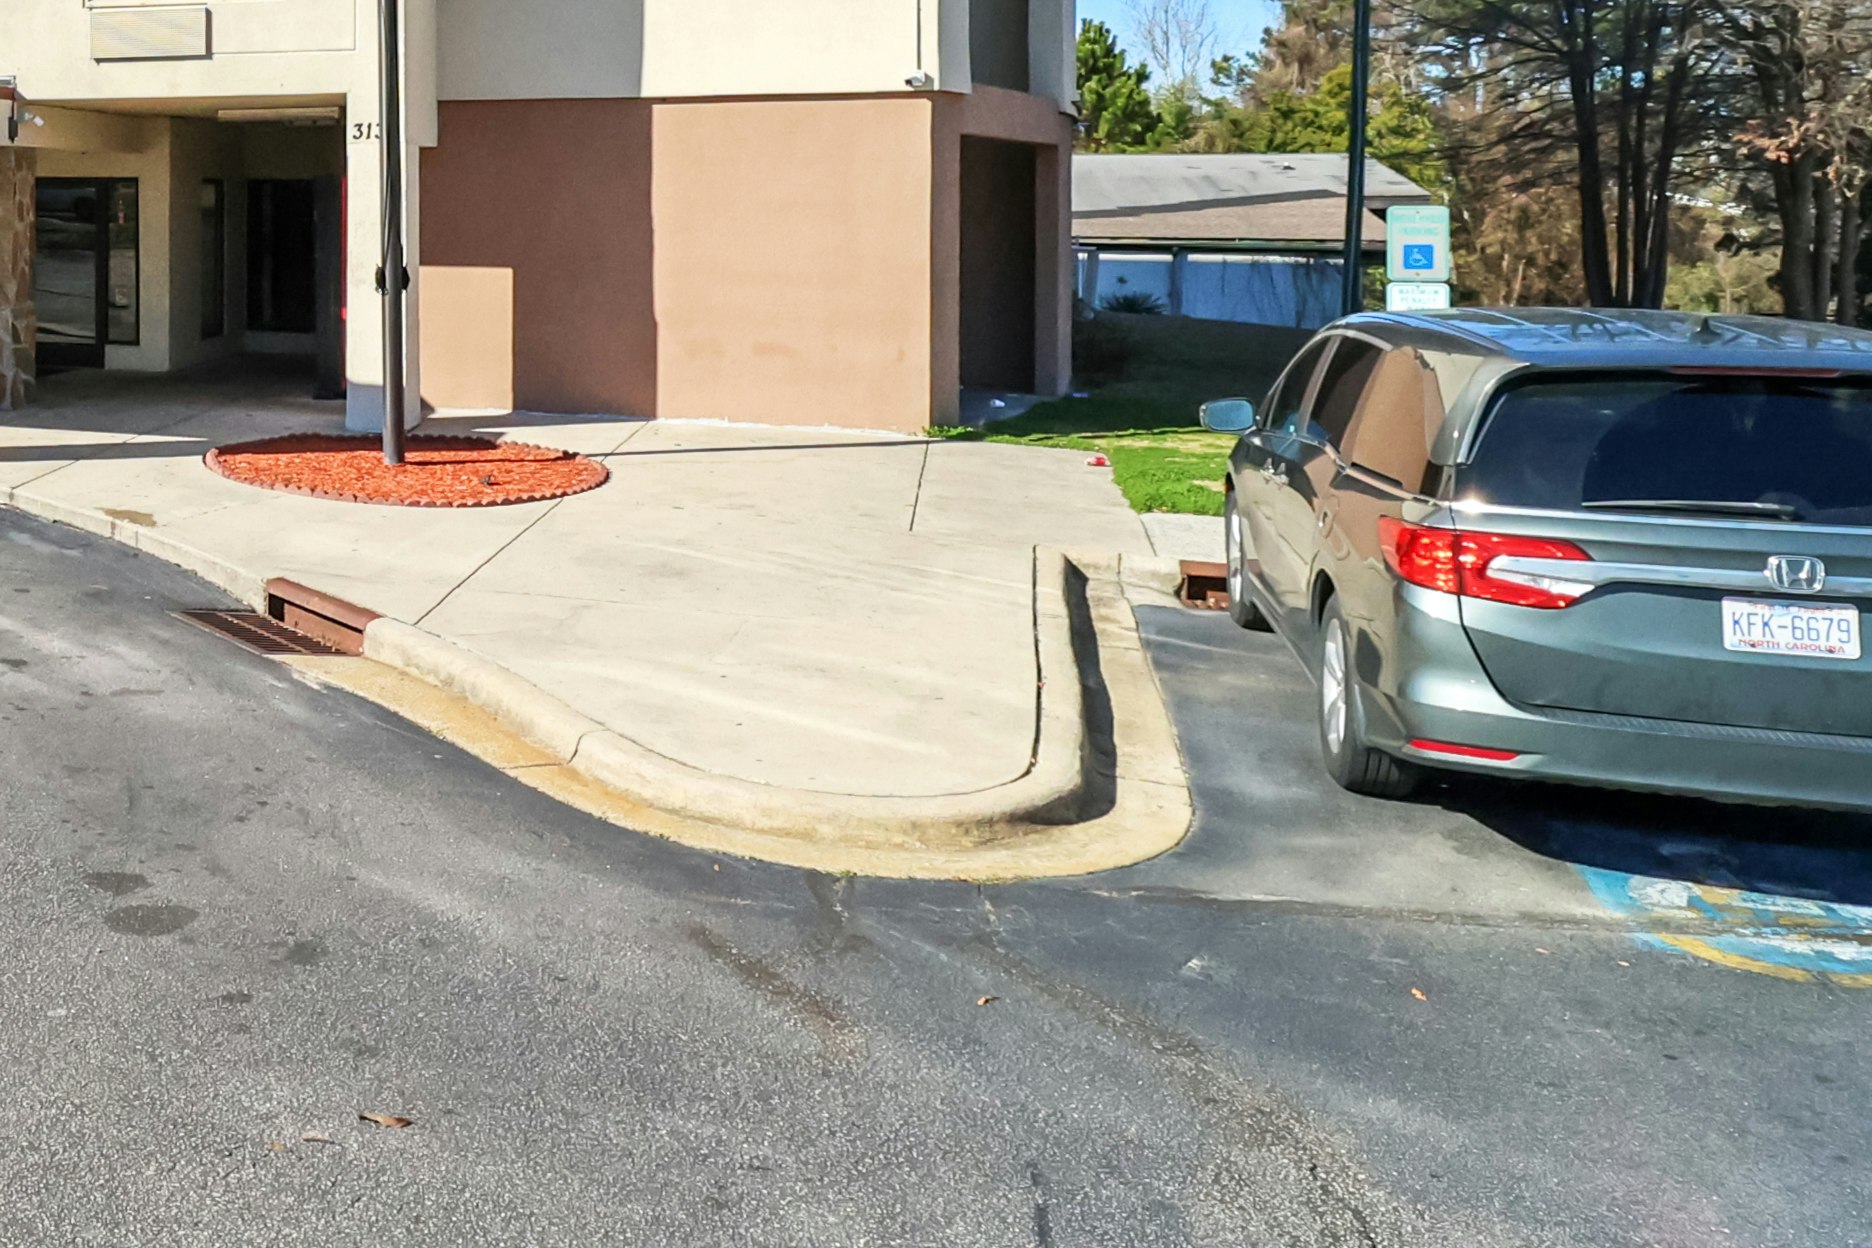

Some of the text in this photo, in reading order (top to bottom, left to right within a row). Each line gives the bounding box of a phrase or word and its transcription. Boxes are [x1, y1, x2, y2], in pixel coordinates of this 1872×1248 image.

[1731, 611, 1852, 644] KFK-6679
[1738, 639, 1846, 654] NORTH CAROLINA
